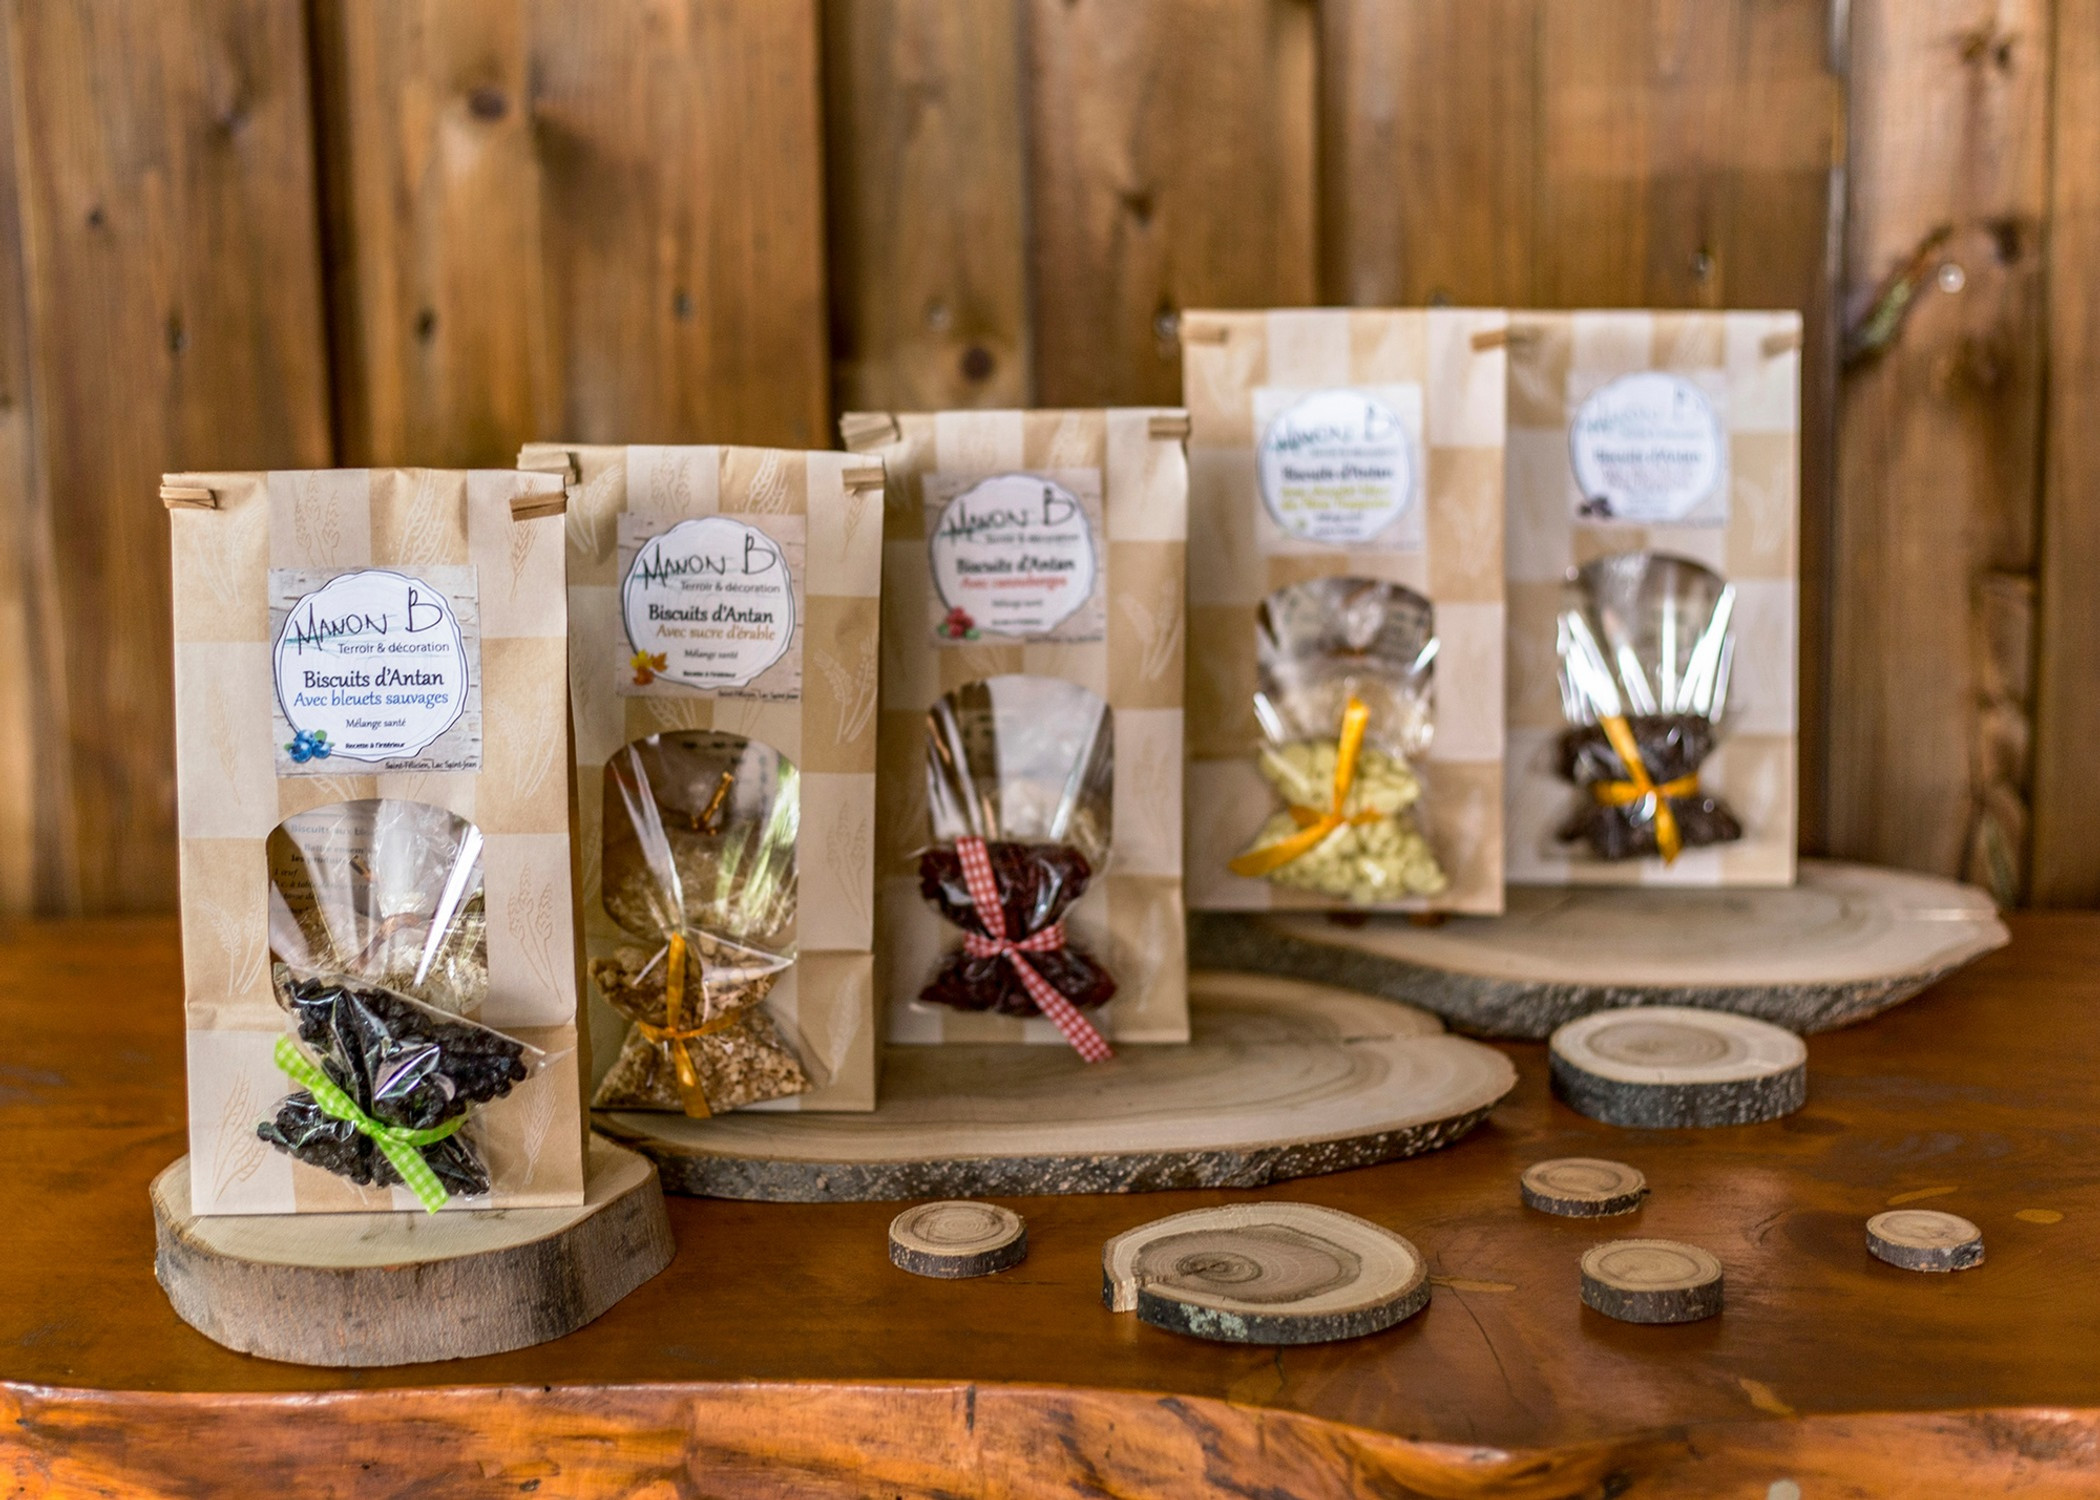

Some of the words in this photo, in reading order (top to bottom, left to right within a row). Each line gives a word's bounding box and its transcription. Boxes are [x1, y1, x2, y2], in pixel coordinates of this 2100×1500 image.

[1043, 487, 1076, 526] B
[643, 543, 726, 591] MANON
[741, 533, 777, 575] B
[957, 558, 1012, 574] Biscuits
[1017, 556, 1075, 572] d'Antan
[681, 580, 713, 592] Terroir
[715, 581, 724, 592] &
[726, 581, 781, 593] décoration
[294, 602, 388, 656] MANON
[405, 586, 443, 633] B
[649, 604, 708, 622] Biscuits
[712, 604, 774, 624] d'Antan
[656, 624, 687, 639] Avec
[690, 627, 723, 640] sucre
[726, 626, 775, 641] d'érable
[337, 643, 375, 654] Terroir
[377, 643, 387, 653] &
[388, 641, 450, 654] décoration
[303, 670, 370, 689] Biscuits
[375, 666, 444, 686] d'Antan
[293, 692, 328, 707] Avec
[331, 690, 382, 706] bleuets
[386, 693, 449, 709] sauvages
[346, 719, 383, 731] Mélange
[384, 719, 406, 728] santé
